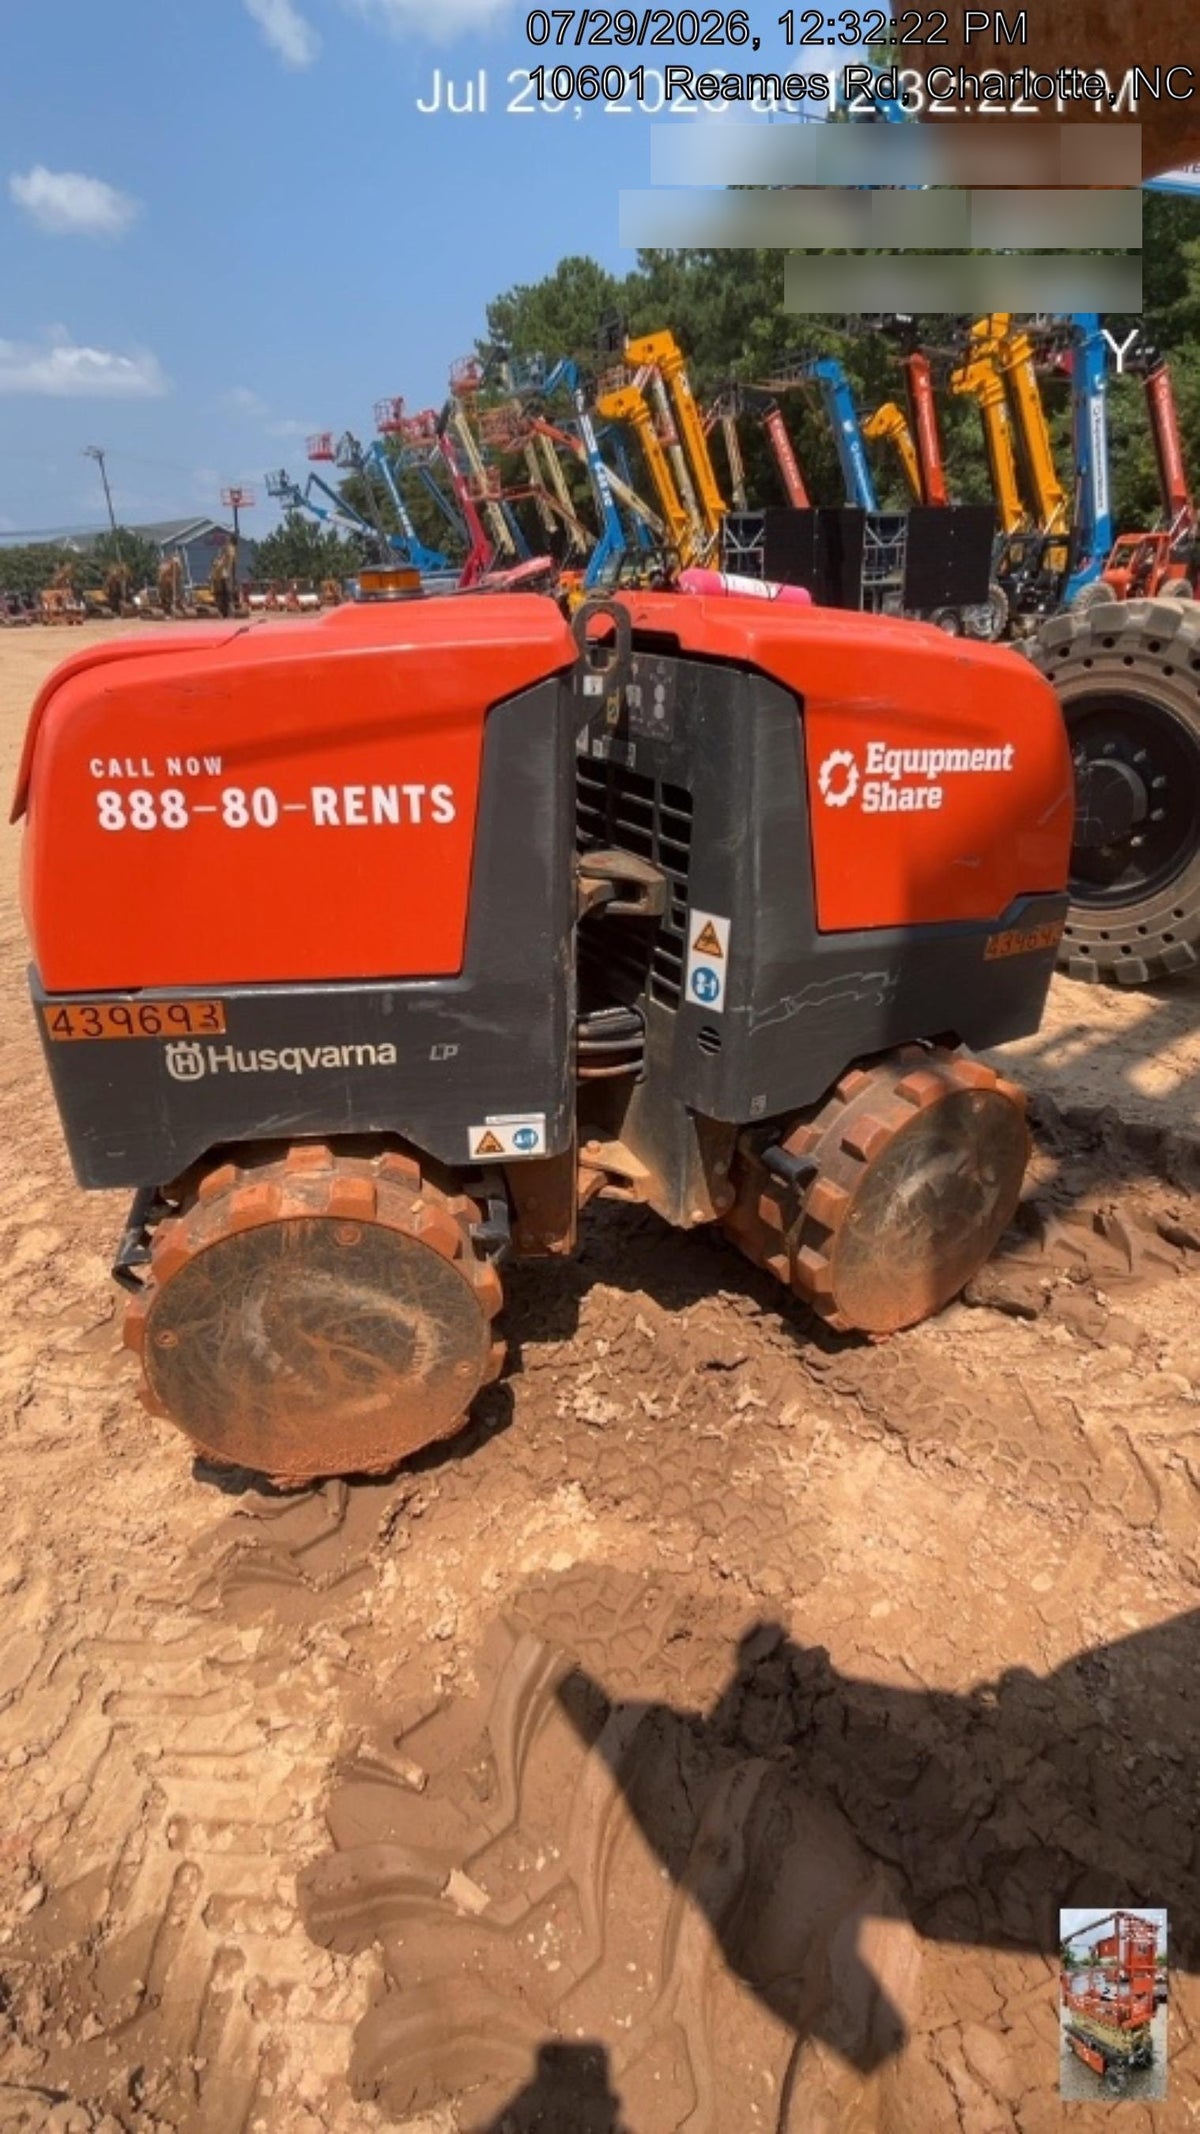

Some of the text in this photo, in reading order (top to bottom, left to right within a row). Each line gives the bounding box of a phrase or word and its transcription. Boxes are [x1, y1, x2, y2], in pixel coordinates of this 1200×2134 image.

[90, 756, 223, 778] CALL NOW
[865, 741, 1015, 780] Equipment
[96, 784, 456, 831] 888-80-RENTS
[861, 781, 943, 813] Share
[51, 1003, 220, 1037] 439693
[207, 1042, 398, 1075] Husqvarna
